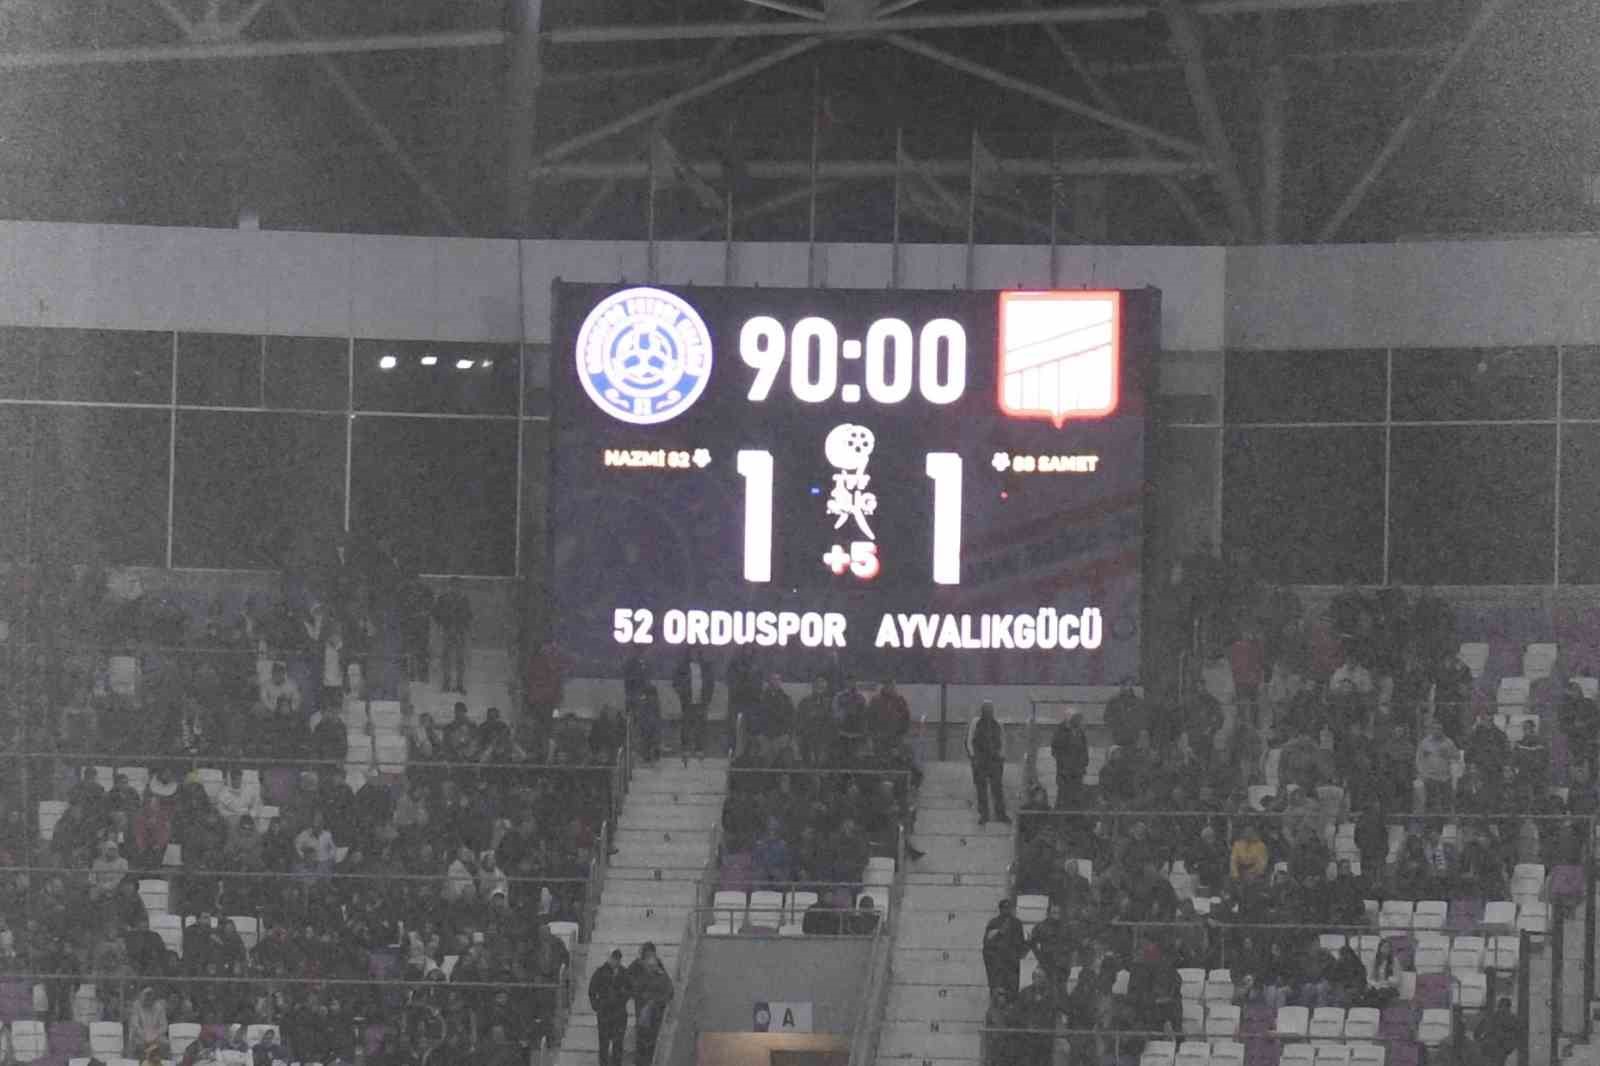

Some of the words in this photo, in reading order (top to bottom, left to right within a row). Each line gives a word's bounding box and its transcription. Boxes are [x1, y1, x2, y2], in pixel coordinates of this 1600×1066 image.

[739, 315, 967, 405] 90:00
[736, 449, 774, 583] 1
[925, 451, 963, 585] 1
[822, 540, 881, 580] +5
[613, 608, 654, 645] 52
[662, 608, 847, 649] ORDUSPOR
[875, 606, 1103, 650] AYVALIKGÜCÜ
[782, 1007, 796, 1027] A
